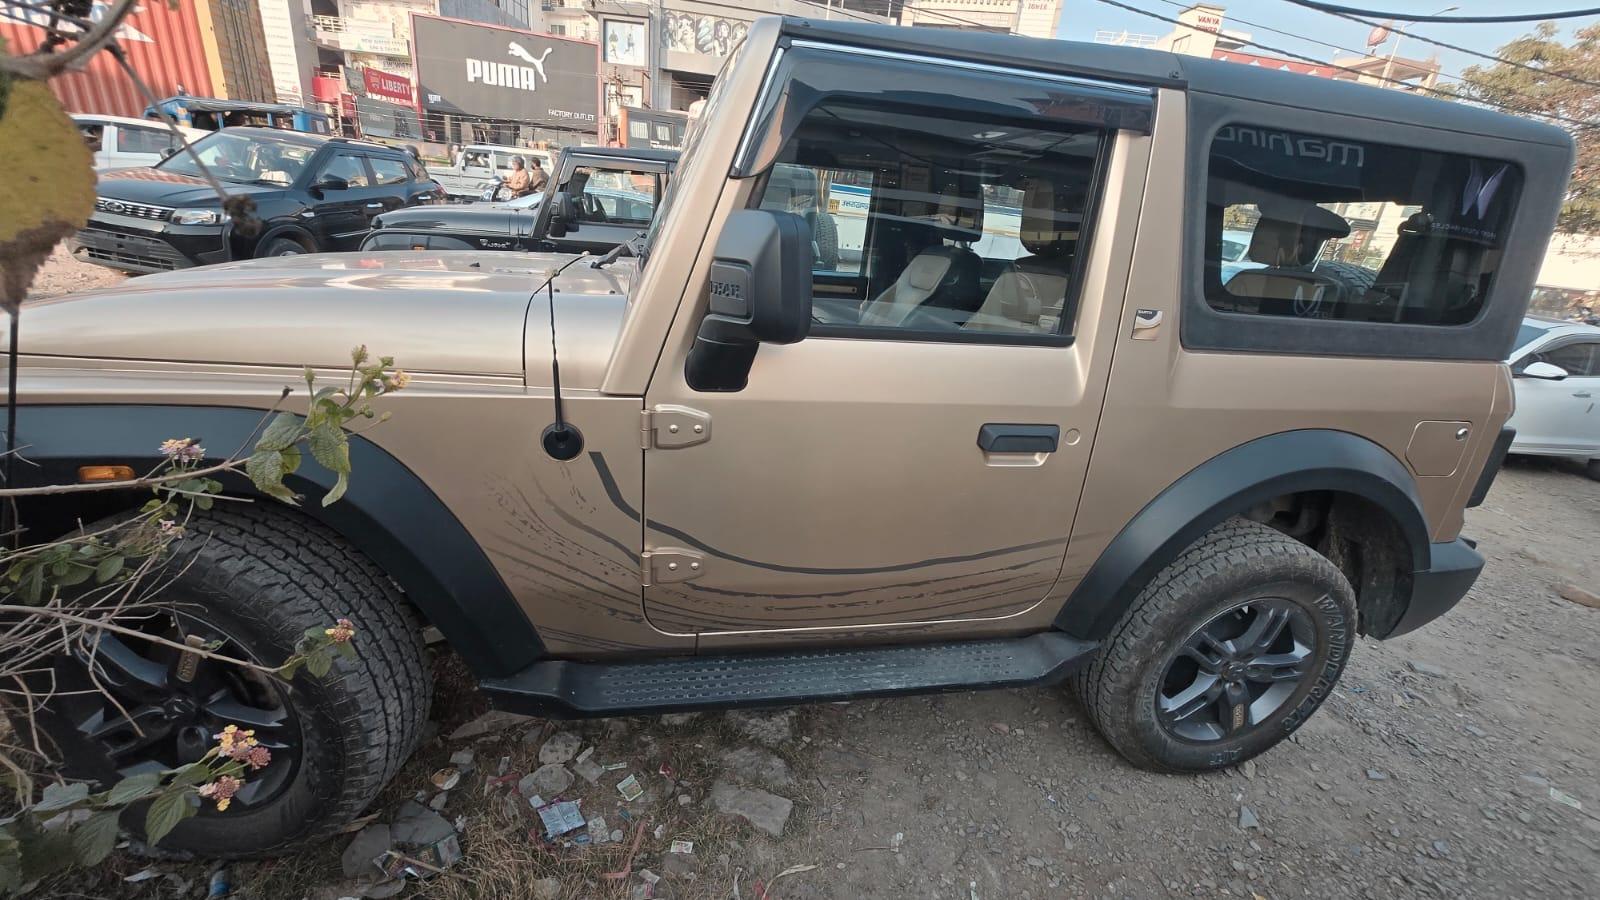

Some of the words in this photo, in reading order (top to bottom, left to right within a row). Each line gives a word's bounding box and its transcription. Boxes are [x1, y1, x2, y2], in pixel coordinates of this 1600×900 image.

[1198, 15, 1220, 25] VANYA
[466, 58, 536, 91] PUMA
[381, 77, 410, 95] LIBERTY
[548, 108, 573, 119] FACTORY
[574, 112, 595, 121] OUTLET
